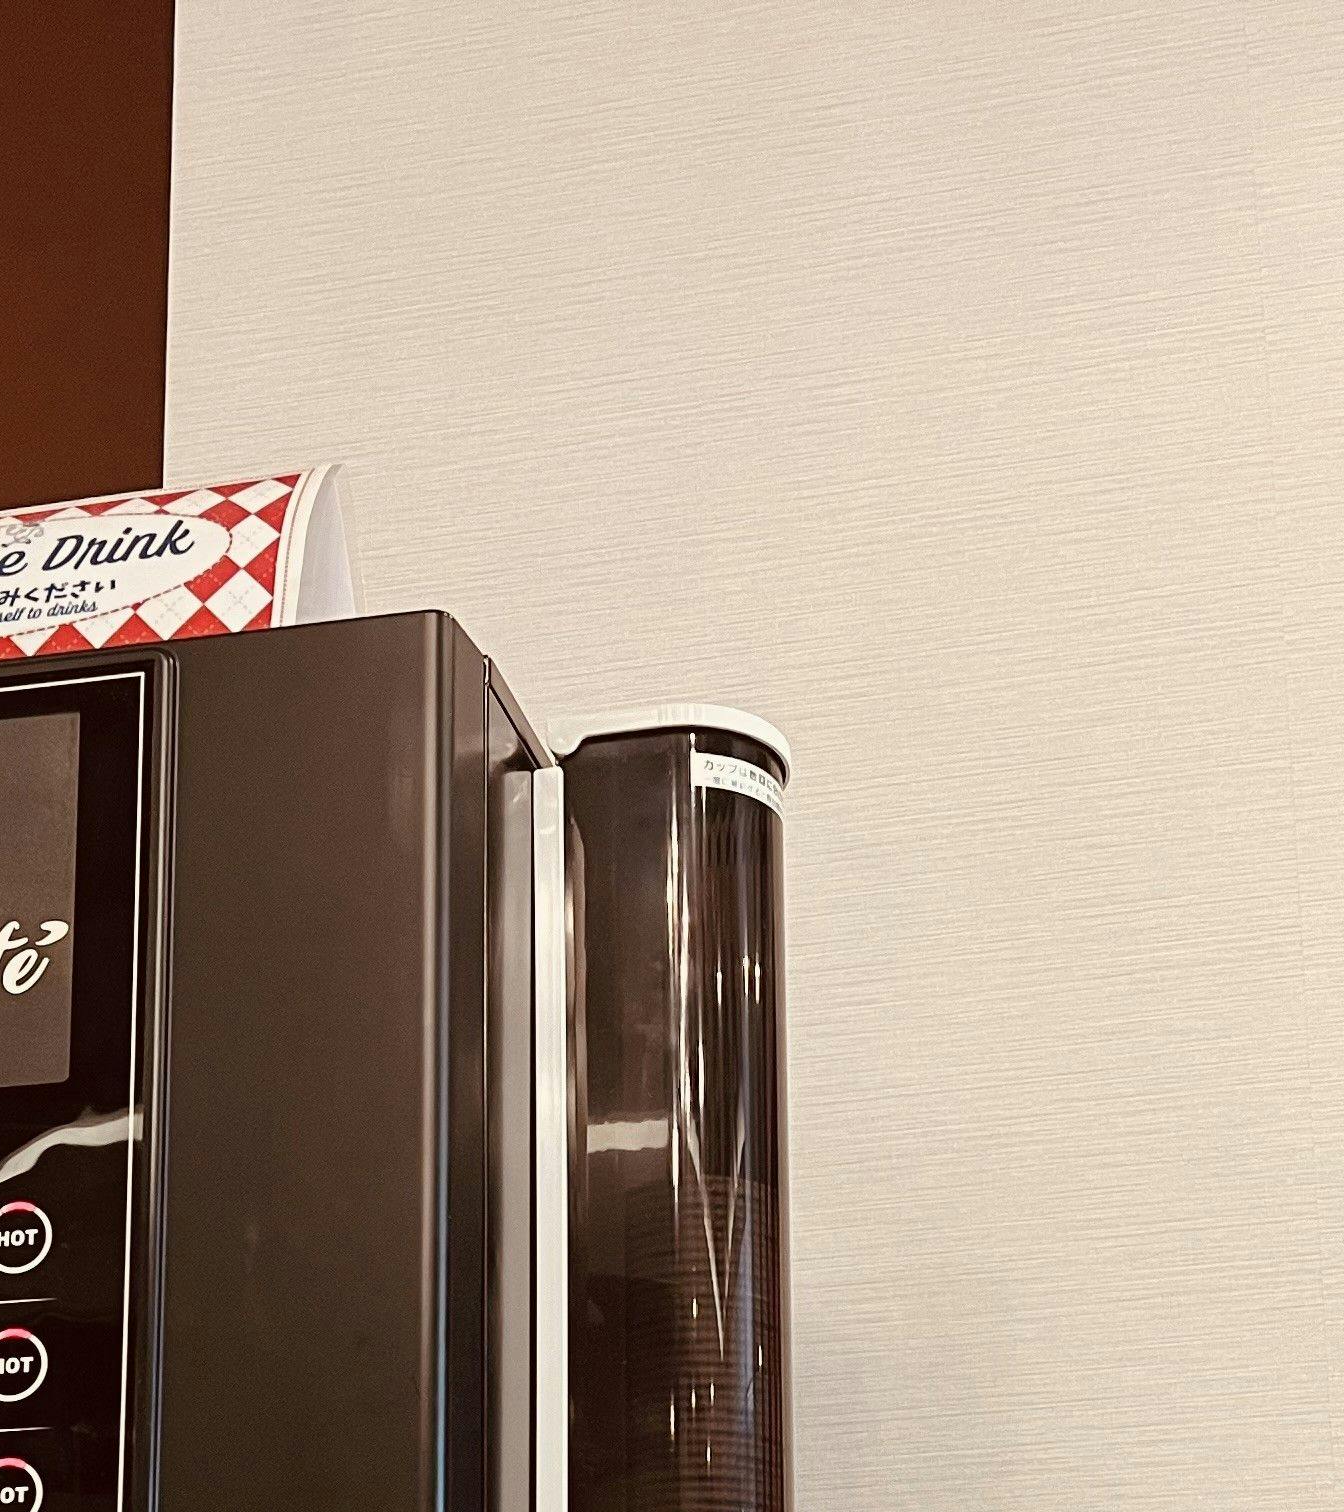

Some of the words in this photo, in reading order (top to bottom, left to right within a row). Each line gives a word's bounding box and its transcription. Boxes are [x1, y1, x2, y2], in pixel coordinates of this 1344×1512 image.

[42, 519, 197, 572] Drink
[27, 607, 42, 620] to
[47, 600, 99, 617] drinks
